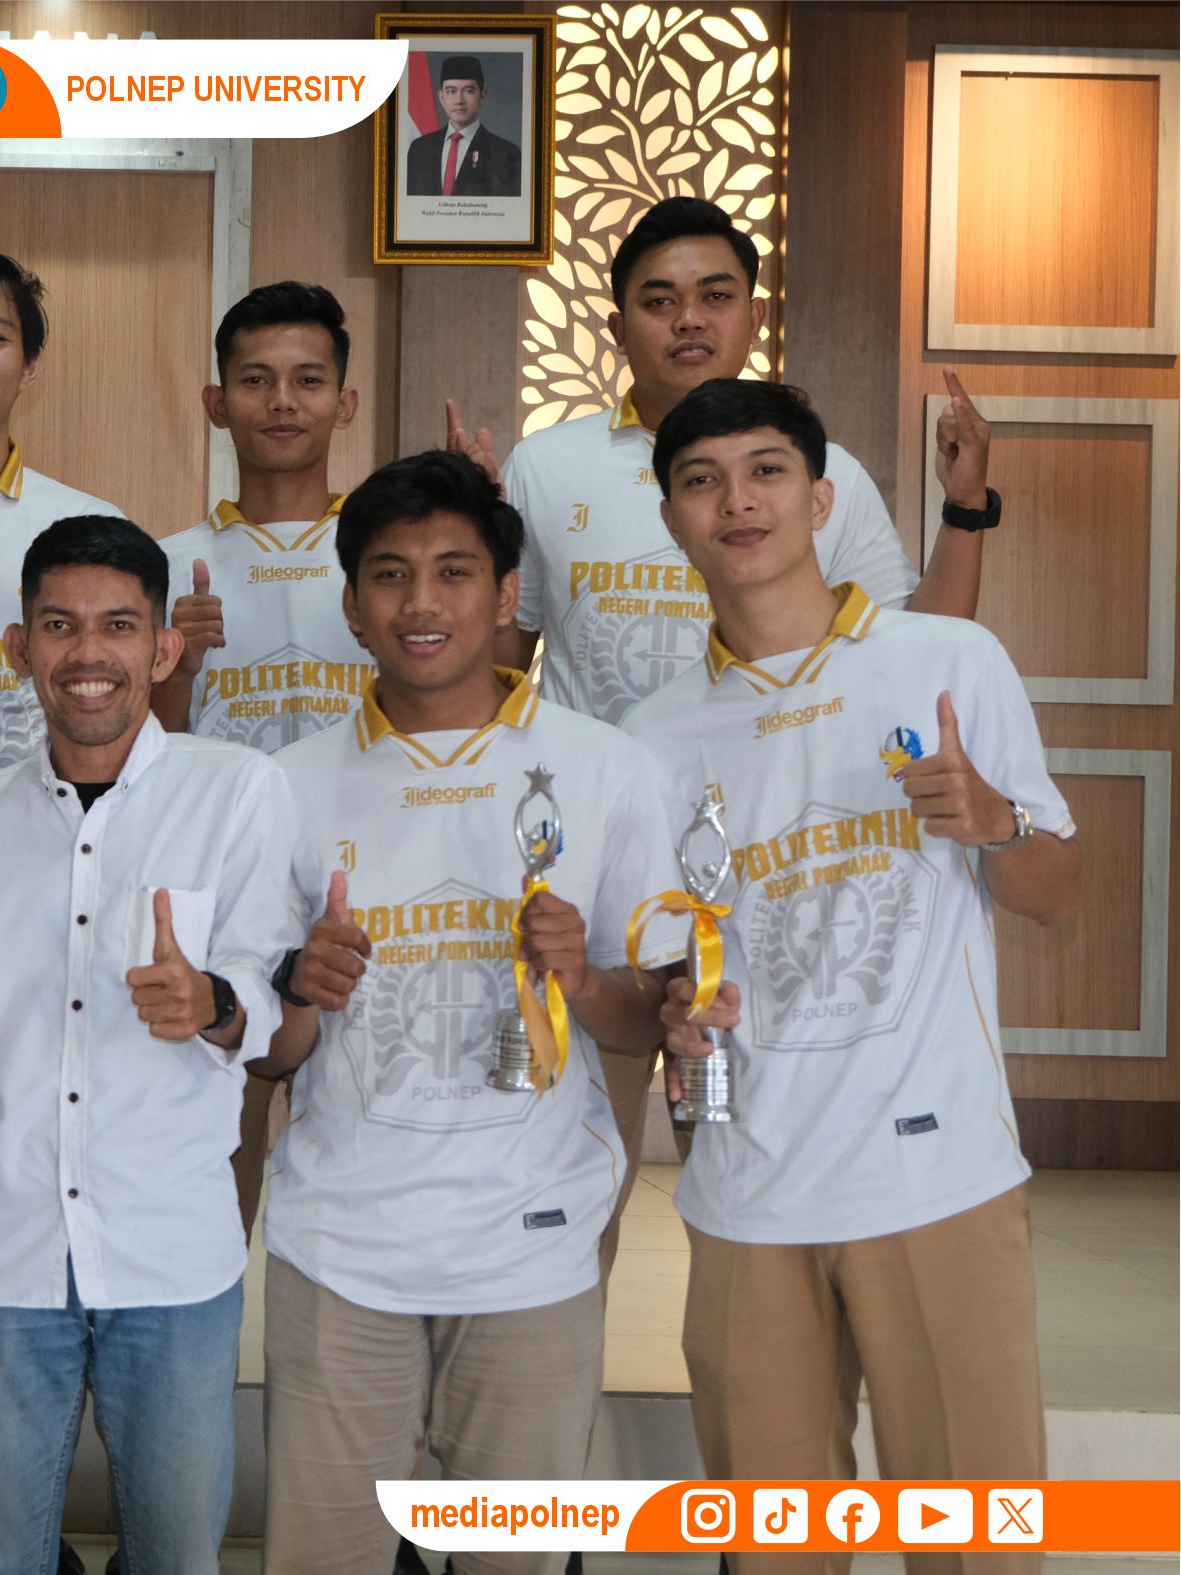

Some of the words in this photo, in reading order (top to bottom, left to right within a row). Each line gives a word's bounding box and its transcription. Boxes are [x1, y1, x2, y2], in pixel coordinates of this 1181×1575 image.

[598, 597, 650, 616] NEGERI
[229, 700, 276, 719] NEGERI
[732, 808, 922, 890] POLITEKNIK
[377, 944, 433, 966] NEGERI
[792, 1002, 859, 1023] POLNEP
[411, 1085, 482, 1101] POLNEP
